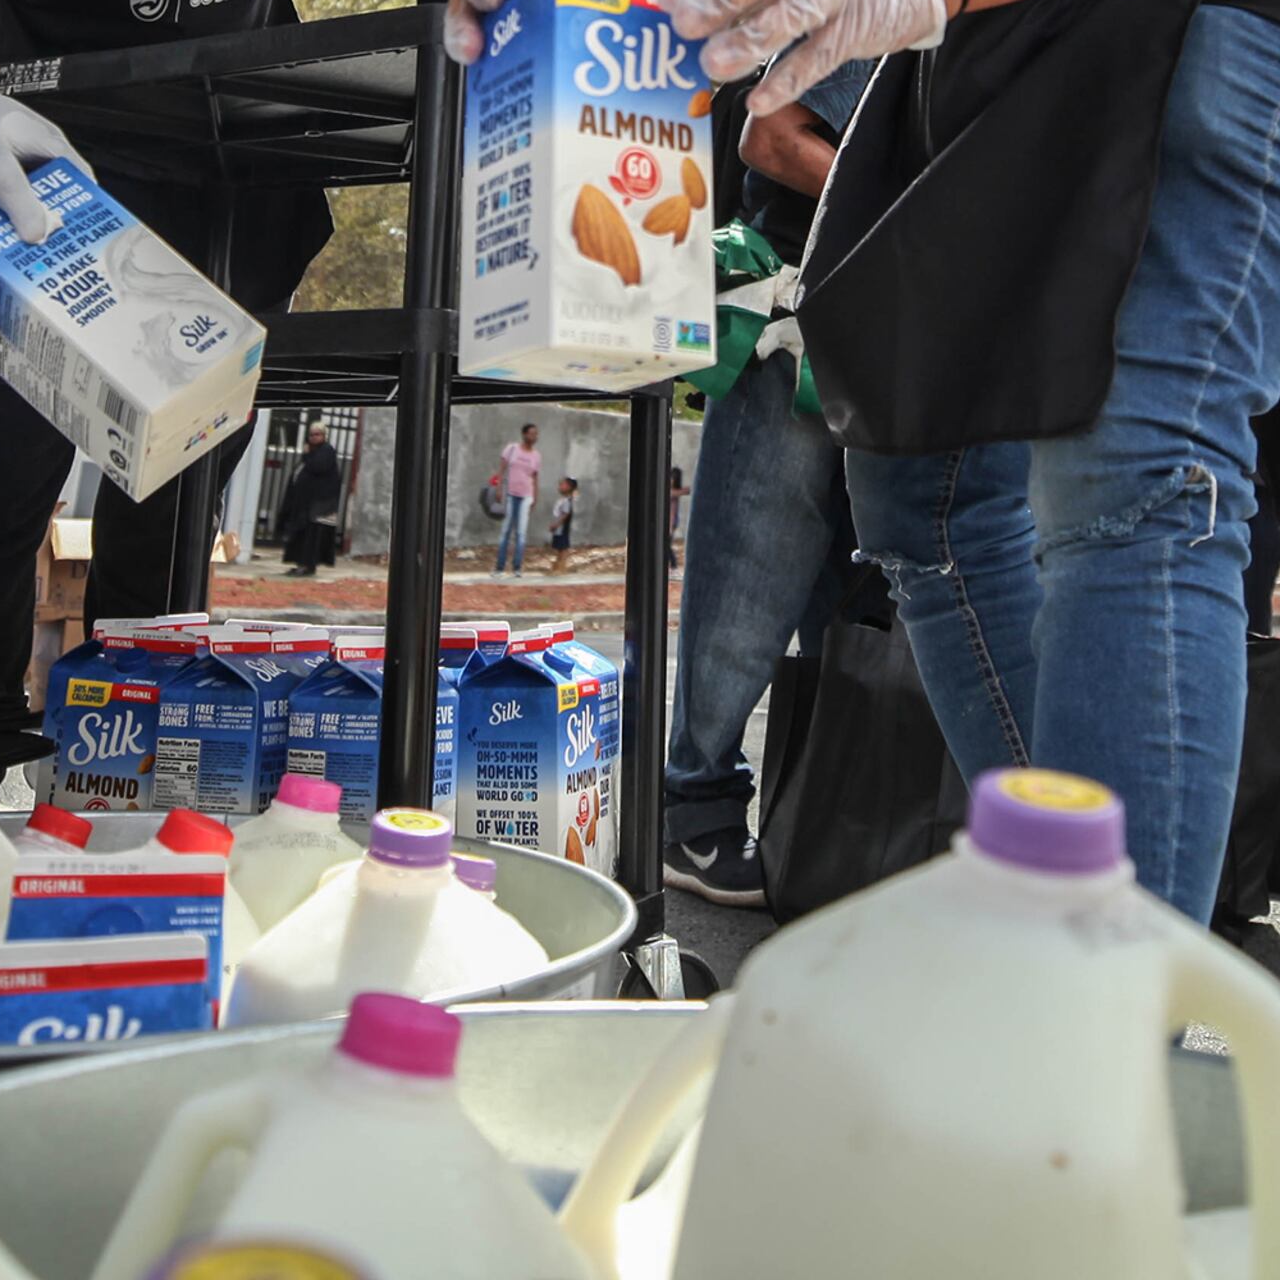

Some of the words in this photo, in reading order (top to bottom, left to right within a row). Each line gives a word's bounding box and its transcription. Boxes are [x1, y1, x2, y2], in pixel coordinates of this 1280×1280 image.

[573, 19, 697, 97] Silk
[578, 104, 694, 153] ALMOND
[626, 156, 652, 180] 60
[47, 231, 71, 251] OUR
[71, 208, 114, 238] PASSION
[55, 242, 80, 263] THE
[79, 216, 125, 248] PLANET
[37, 277, 59, 295] TO
[58, 252, 98, 279] MAKE
[50, 269, 105, 308] YOUR
[67, 282, 113, 319] JOURNEY
[76, 296, 118, 328] SMOOTH
[179, 314, 218, 347] Silk
[107, 639, 136, 649] ORIGINAL
[244, 657, 287, 683] Silk
[122, 689, 152, 700] ORIGINAL
[195, 704, 216, 715] FREE
[264, 700, 278, 717] WE
[321, 713, 340, 725] FREE
[489, 700, 523, 726] Silk
[158, 716, 188, 727] BONES
[68, 709, 147, 766] Silk
[564, 704, 596, 768] Silk
[187, 764, 197, 773] 60
[477, 751, 538, 763] OH-SO-MMM
[477, 765, 538, 780] MOMENTS
[566, 767, 597, 795] ALMOND
[65, 771, 139, 800] ALMOND
[433, 782, 451, 797] ANET
[477, 790, 508, 801] WORLD
[510, 781, 519, 789] DO
[476, 809, 487, 819] WE
[490, 809, 515, 819] OFFSET
[517, 810, 538, 819] 100%
[476, 820, 491, 834] OF
[20, 878, 86, 894] ORIGINAL
